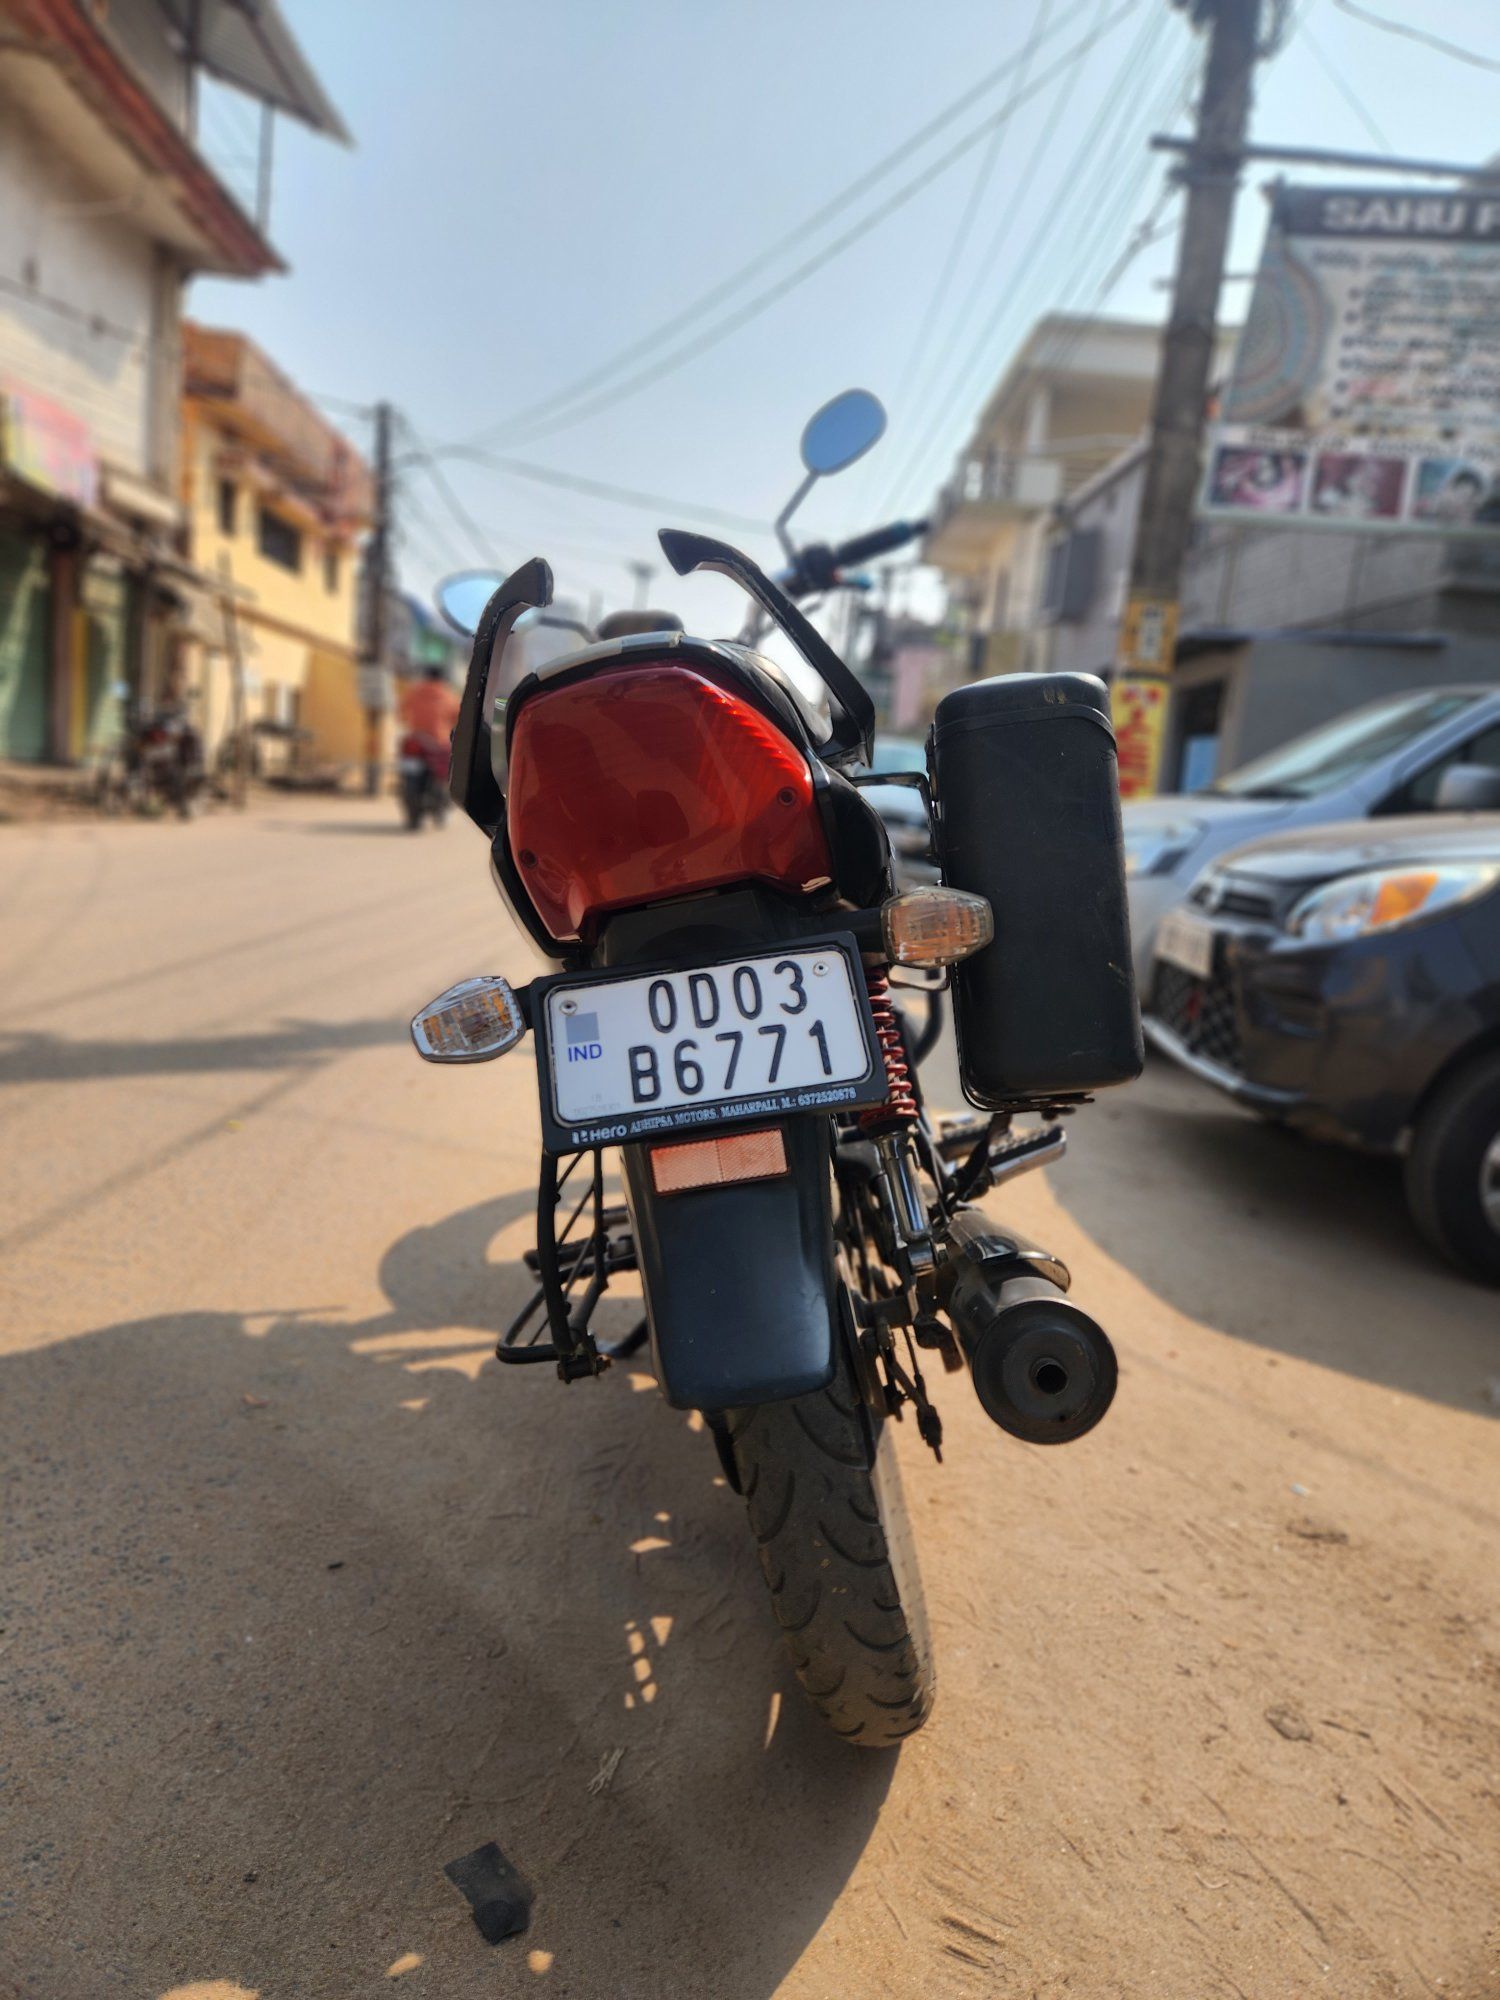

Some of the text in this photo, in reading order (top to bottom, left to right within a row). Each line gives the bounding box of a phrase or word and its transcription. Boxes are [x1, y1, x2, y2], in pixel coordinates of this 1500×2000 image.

[1323, 198, 1466, 234] SAHU
[568, 1043, 602, 1062] IND
[628, 1019, 833, 1104] B6771
[589, 1124, 627, 1142] Hero
